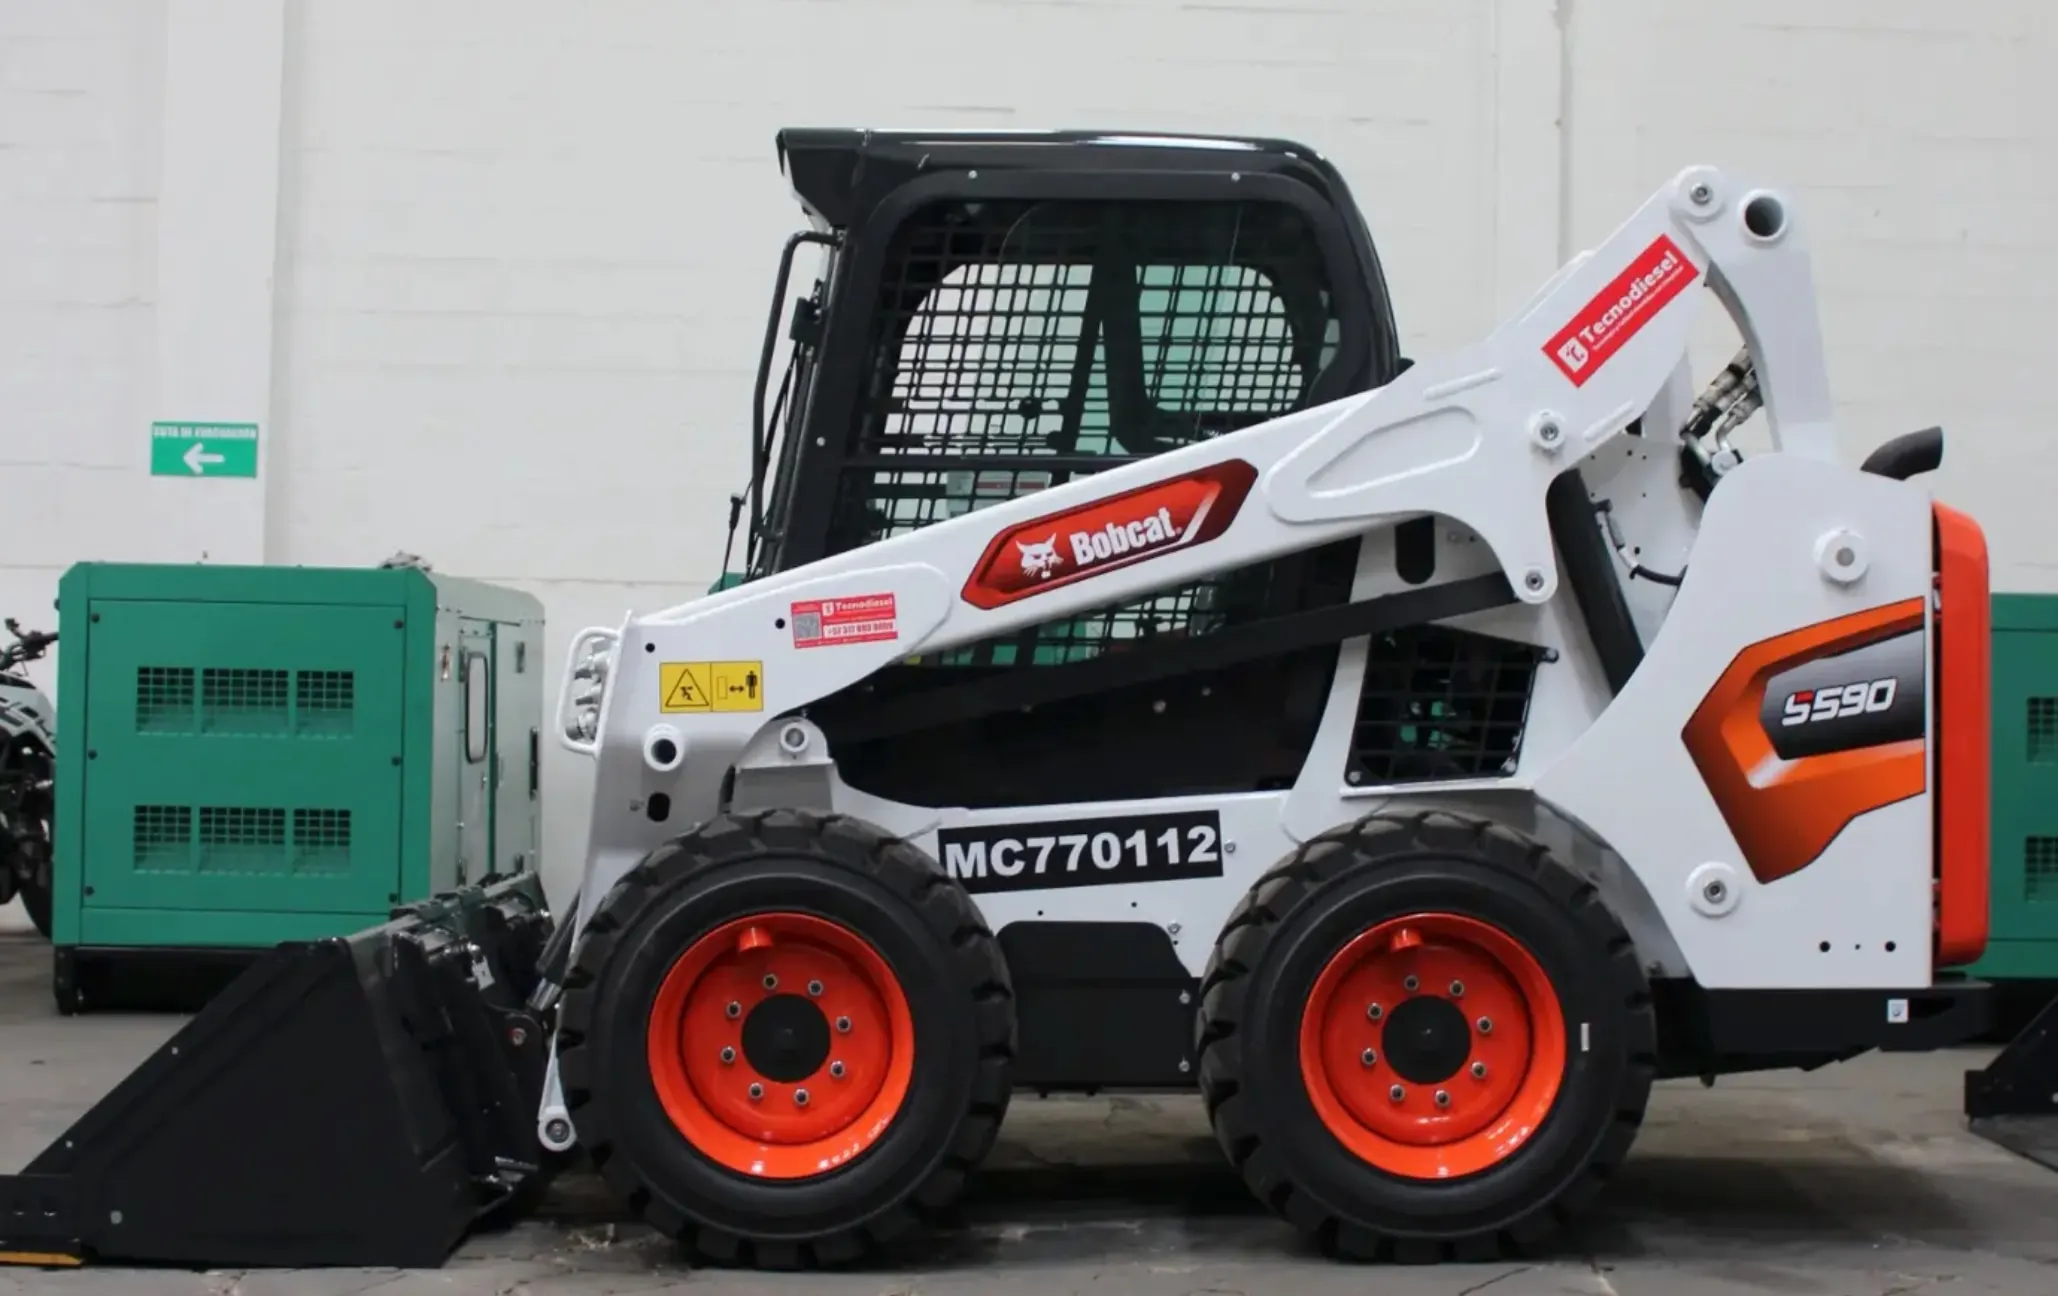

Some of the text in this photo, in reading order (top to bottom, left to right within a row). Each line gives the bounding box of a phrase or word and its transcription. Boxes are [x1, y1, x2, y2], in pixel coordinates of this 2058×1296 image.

[1578, 249, 1679, 343] Tecnodiesel
[1069, 507, 1176, 566] Bobcat
[835, 597, 893, 611] Tecnodiesel
[1781, 678, 1897, 727] S590
[945, 825, 1218, 879] MC770112
